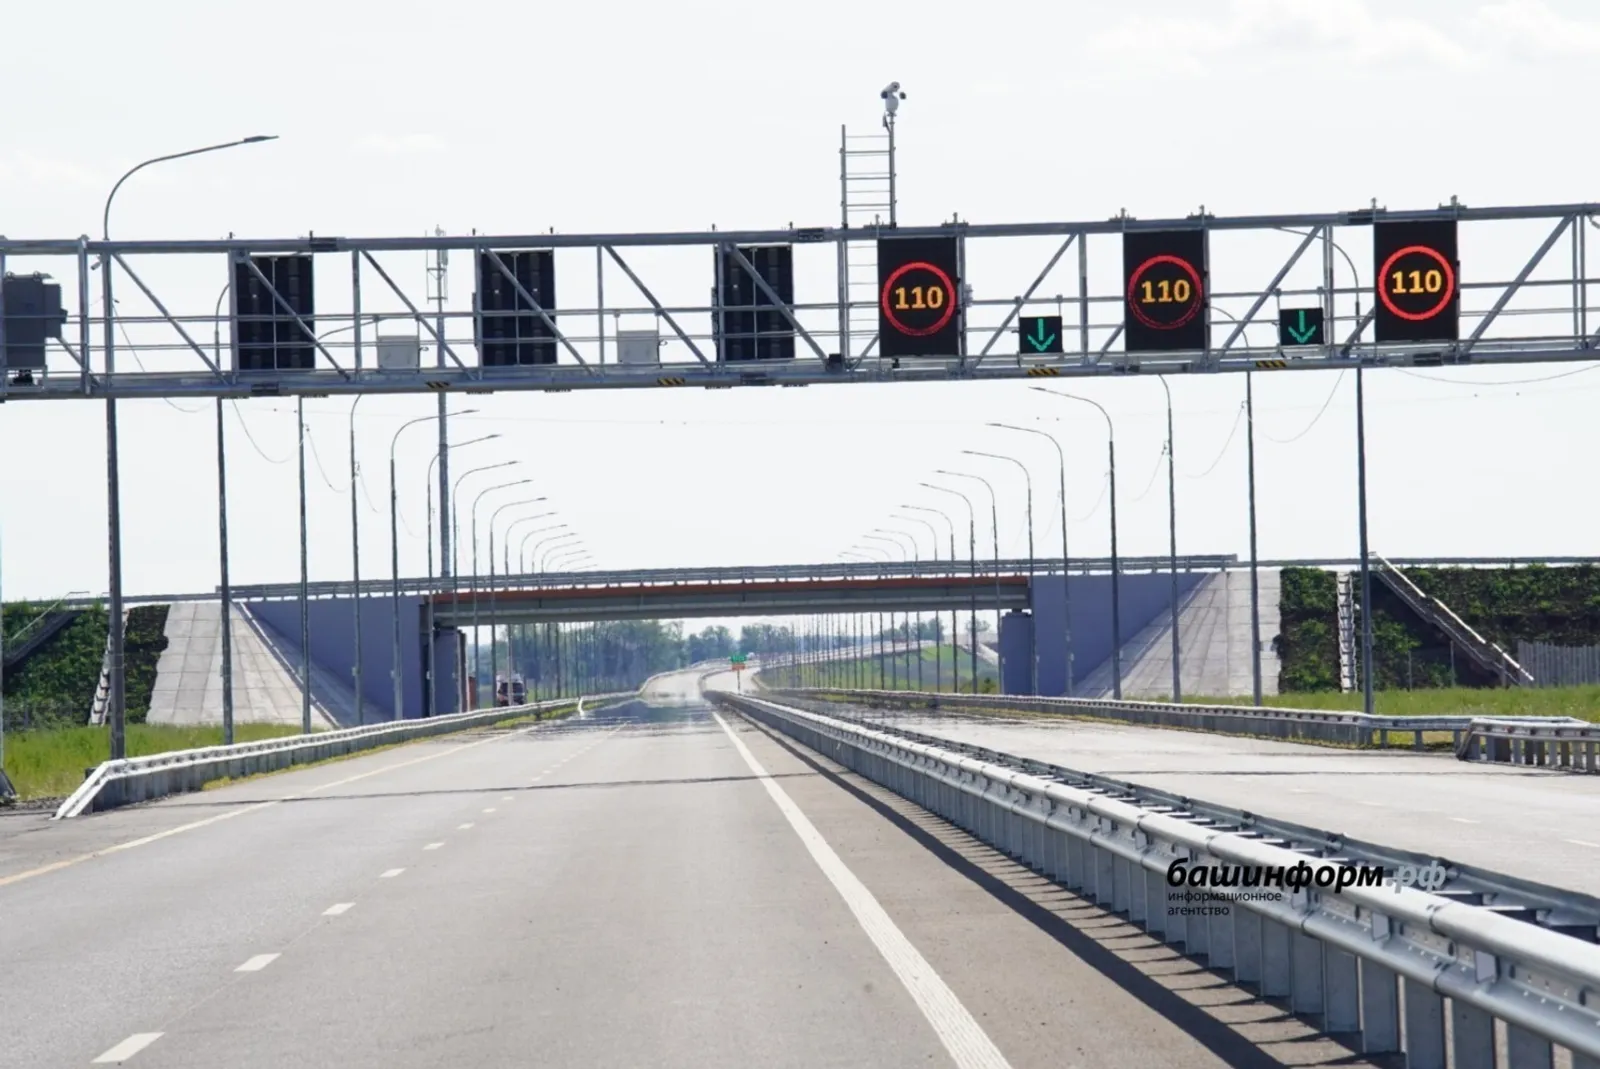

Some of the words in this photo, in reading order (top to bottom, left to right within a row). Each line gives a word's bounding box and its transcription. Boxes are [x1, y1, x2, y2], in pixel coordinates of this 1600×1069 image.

[1141, 279, 1190, 304] 110
[1392, 269, 1442, 294] 110
[895, 286, 943, 310] 110
